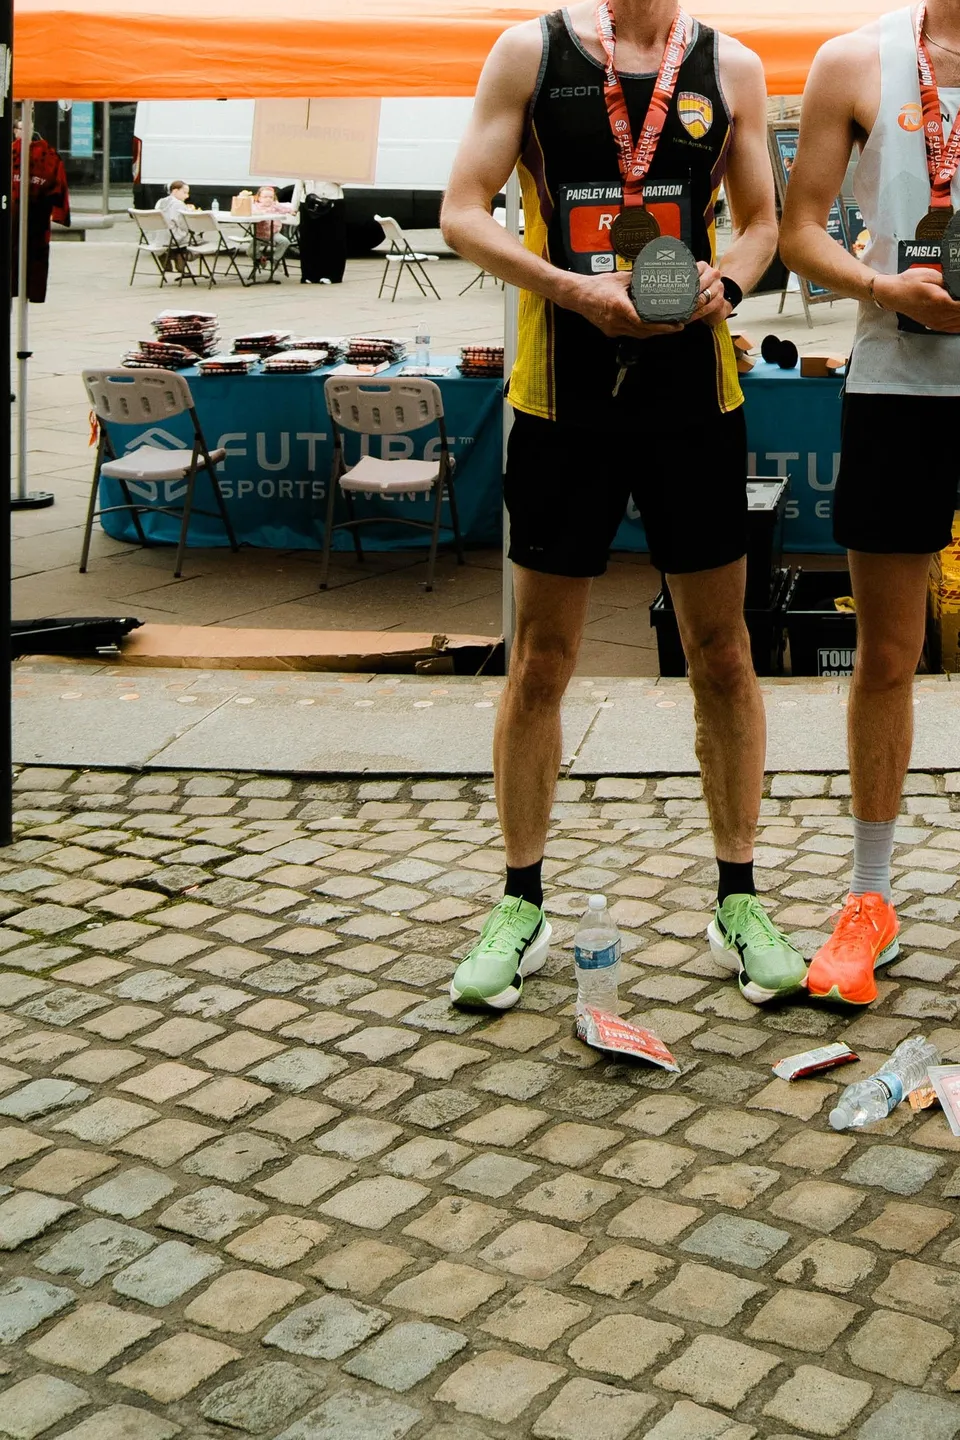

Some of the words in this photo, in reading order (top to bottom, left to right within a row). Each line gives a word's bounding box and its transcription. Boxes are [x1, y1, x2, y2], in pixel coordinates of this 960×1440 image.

[666, 43, 681, 64] HALF
[659, 61, 676, 91] PAISLEY
[622, 134, 633, 173] FUTUR
[636, 125, 653, 163] FUTURE
[933, 136, 941, 168] FUTUR
[566, 188, 606, 201] PAISLEY
[606, 186, 623, 199] HAL
[642, 184, 683, 197] ARATHON
[905, 245, 941, 257] PAISLEY
[640, 274, 690, 283] PAISLEY
[218, 479, 326, 499] SPORTS
[819, 650, 857, 668] TOU
